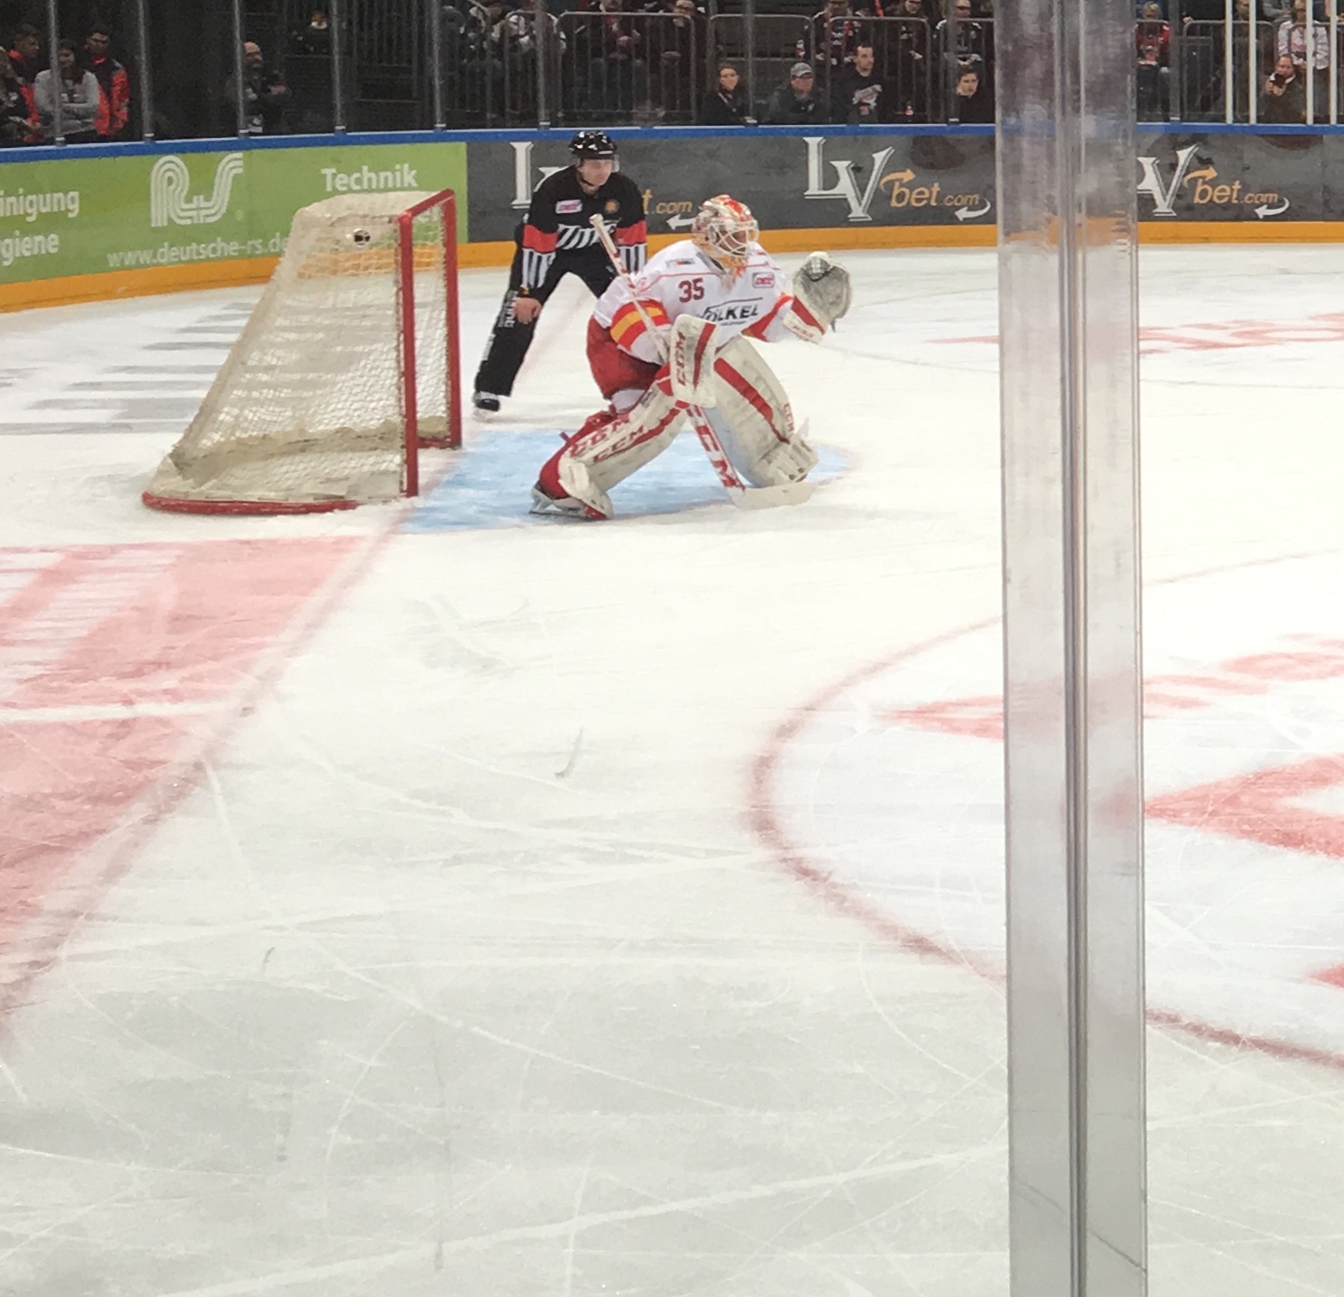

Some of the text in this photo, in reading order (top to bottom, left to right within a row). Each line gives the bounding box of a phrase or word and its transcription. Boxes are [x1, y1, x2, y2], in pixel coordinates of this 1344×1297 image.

[320, 162, 418, 192] Technik
[802, 136, 896, 223] LV
[0, 187, 80, 223] inigung
[0, 229, 60, 267] giene
[106, 231, 289, 268] www.deutsche-rs.de
[678, 278, 705, 303] 35
